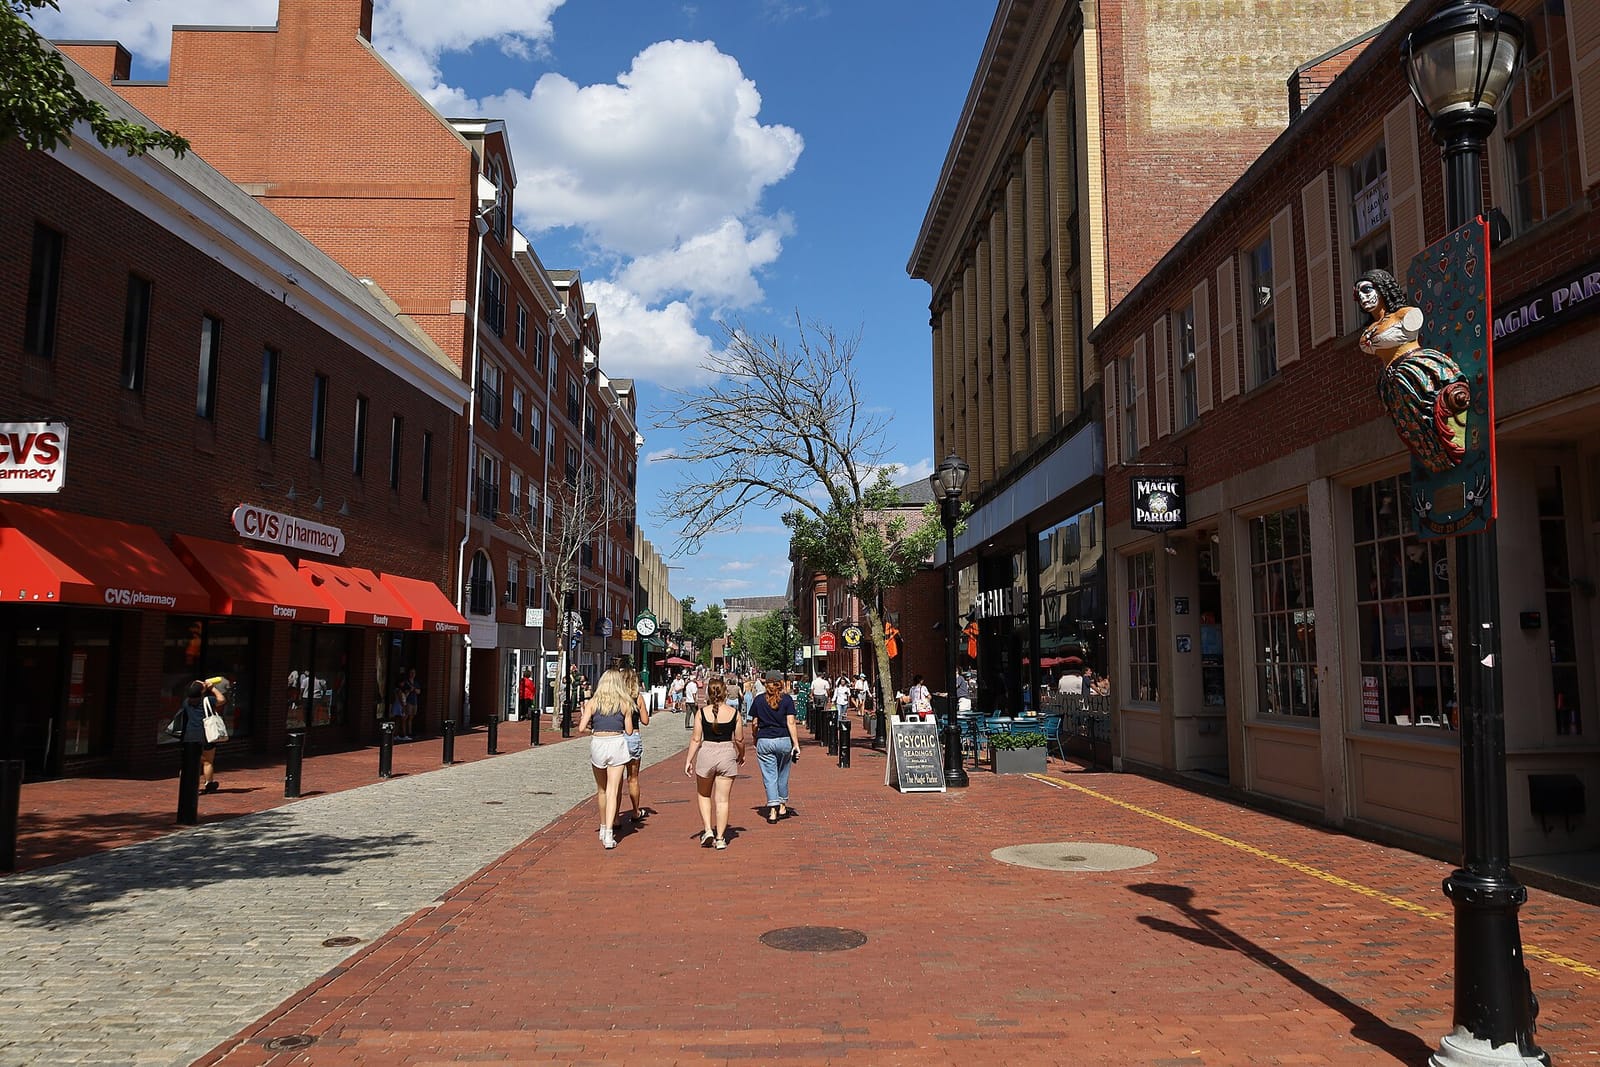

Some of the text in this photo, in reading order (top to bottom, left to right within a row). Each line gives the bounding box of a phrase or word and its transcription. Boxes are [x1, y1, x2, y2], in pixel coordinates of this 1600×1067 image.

[1551, 272, 1600, 314] PAR
[1136, 480, 1180, 501] MAGIC
[1136, 507, 1182, 523] PARLOR
[243, 509, 339, 553] CVS/pharmacy
[105, 588, 177, 608] CVS/pharmacy
[273, 605, 297, 620] Grocery
[897, 733, 936, 749] PSYCHIC
